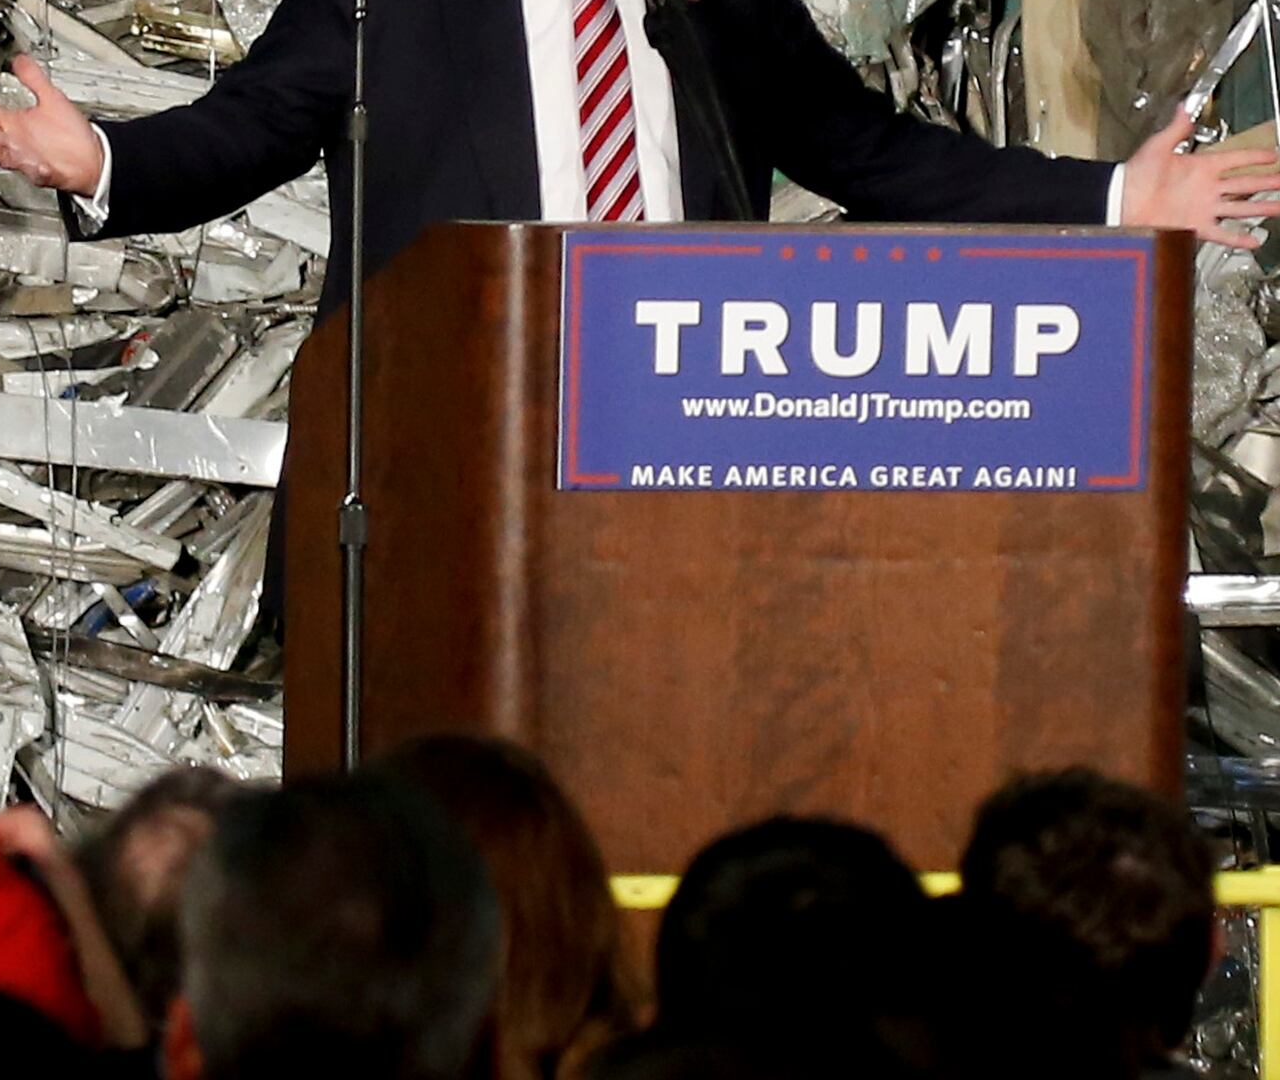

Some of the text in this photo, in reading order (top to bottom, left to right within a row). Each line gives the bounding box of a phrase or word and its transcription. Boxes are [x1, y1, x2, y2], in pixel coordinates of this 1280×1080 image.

[634, 299, 1081, 378] TRUMP
[680, 391, 1032, 424] www.DonaldJTrump.com
[630, 464, 1077, 489] MAKE AMERICA GREAT AGAIN!
